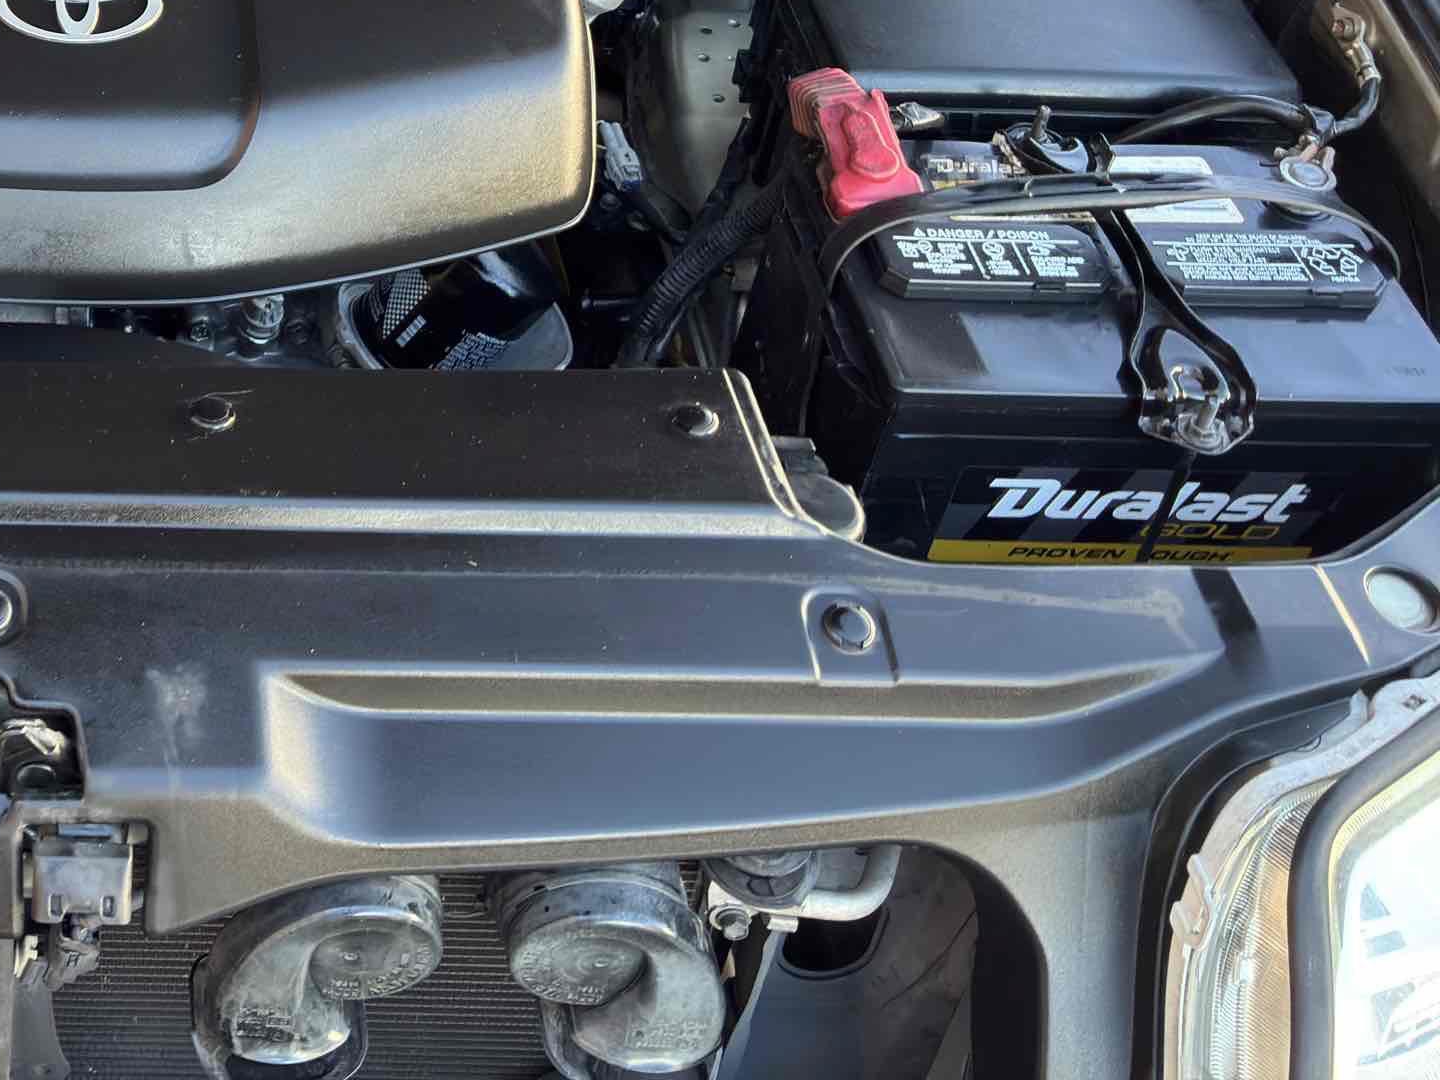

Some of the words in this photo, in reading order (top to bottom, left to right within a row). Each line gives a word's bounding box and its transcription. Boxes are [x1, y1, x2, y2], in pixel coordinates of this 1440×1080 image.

[926, 228, 984, 240] DANGER
[997, 230, 1050, 241] POISON
[987, 478, 1308, 523] Duralast
[1007, 546, 1126, 560] PROVEN
[1146, 548, 1233, 561] OUGH
